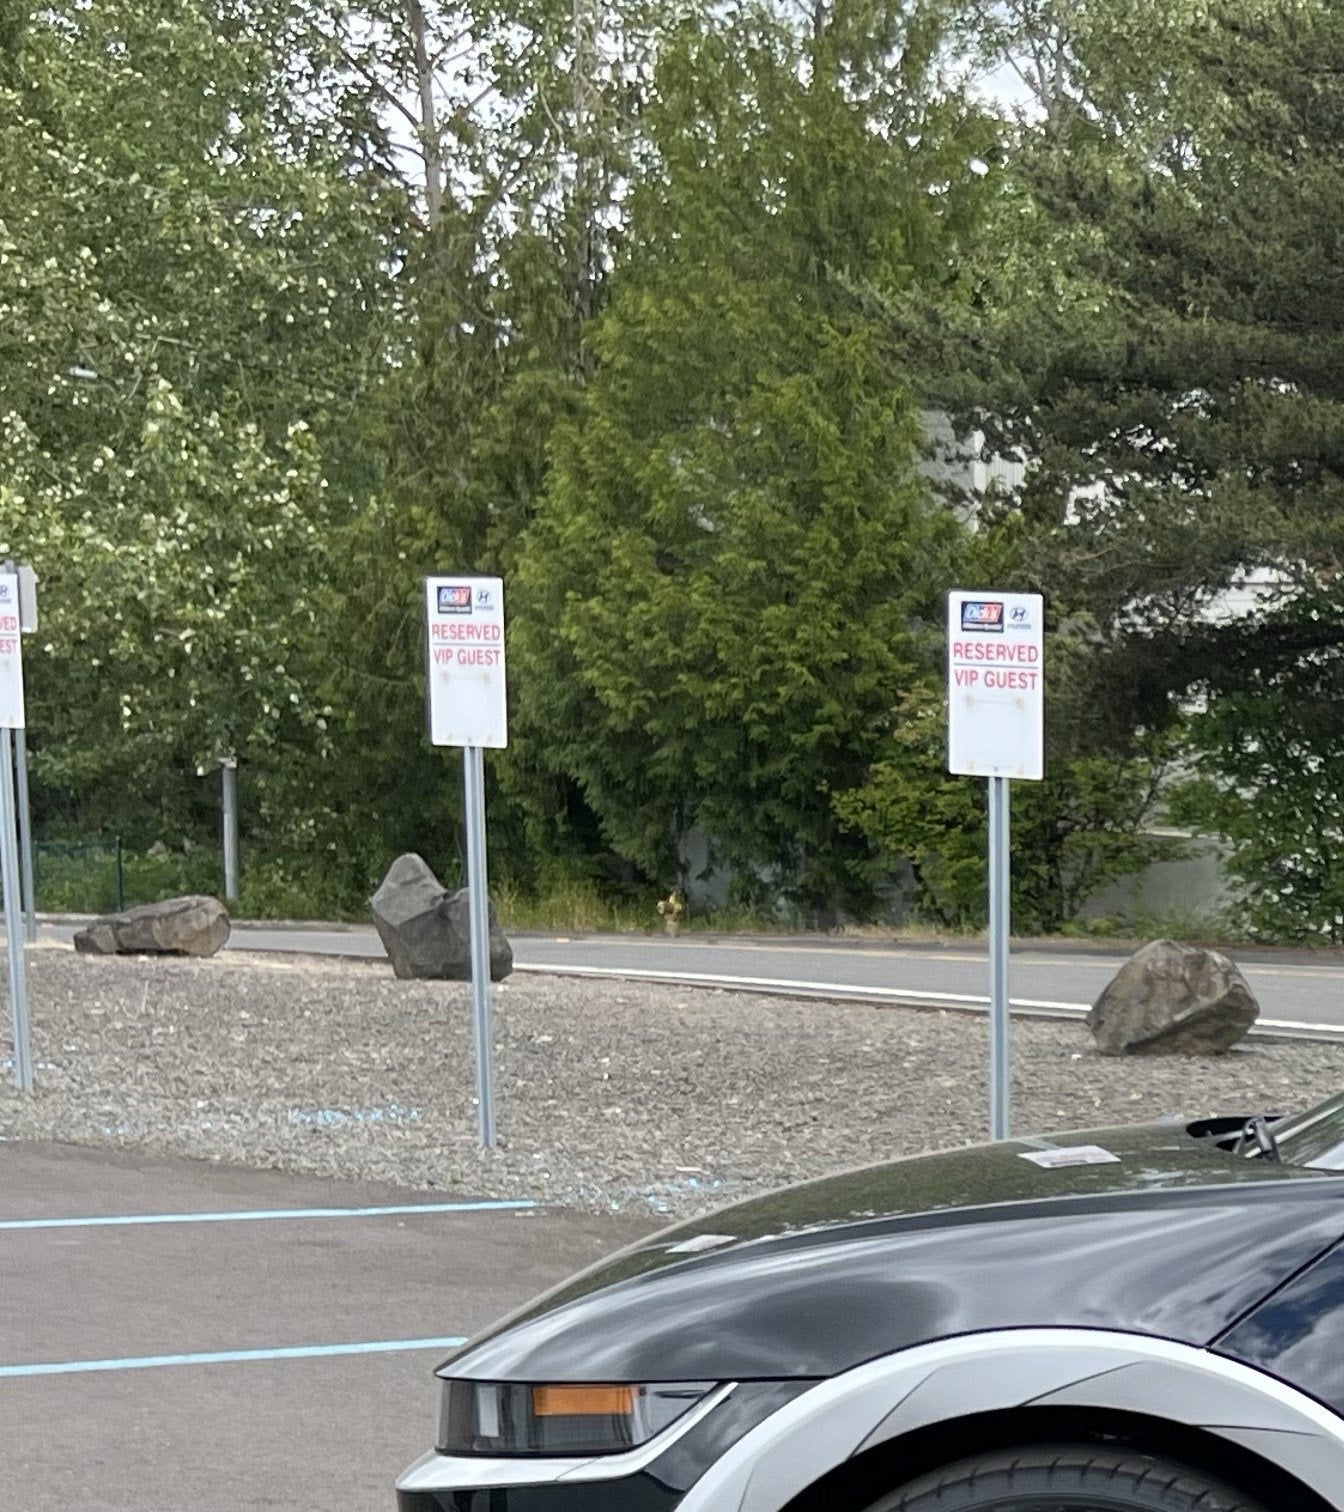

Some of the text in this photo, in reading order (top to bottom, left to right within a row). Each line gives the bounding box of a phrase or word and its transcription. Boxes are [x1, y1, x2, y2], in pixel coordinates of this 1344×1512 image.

[432, 623, 500, 641] RESERVED
[434, 647, 501, 666] VIP GUEST
[954, 642, 1039, 663] RESERVED
[954, 669, 1038, 690] VIP GUEST
